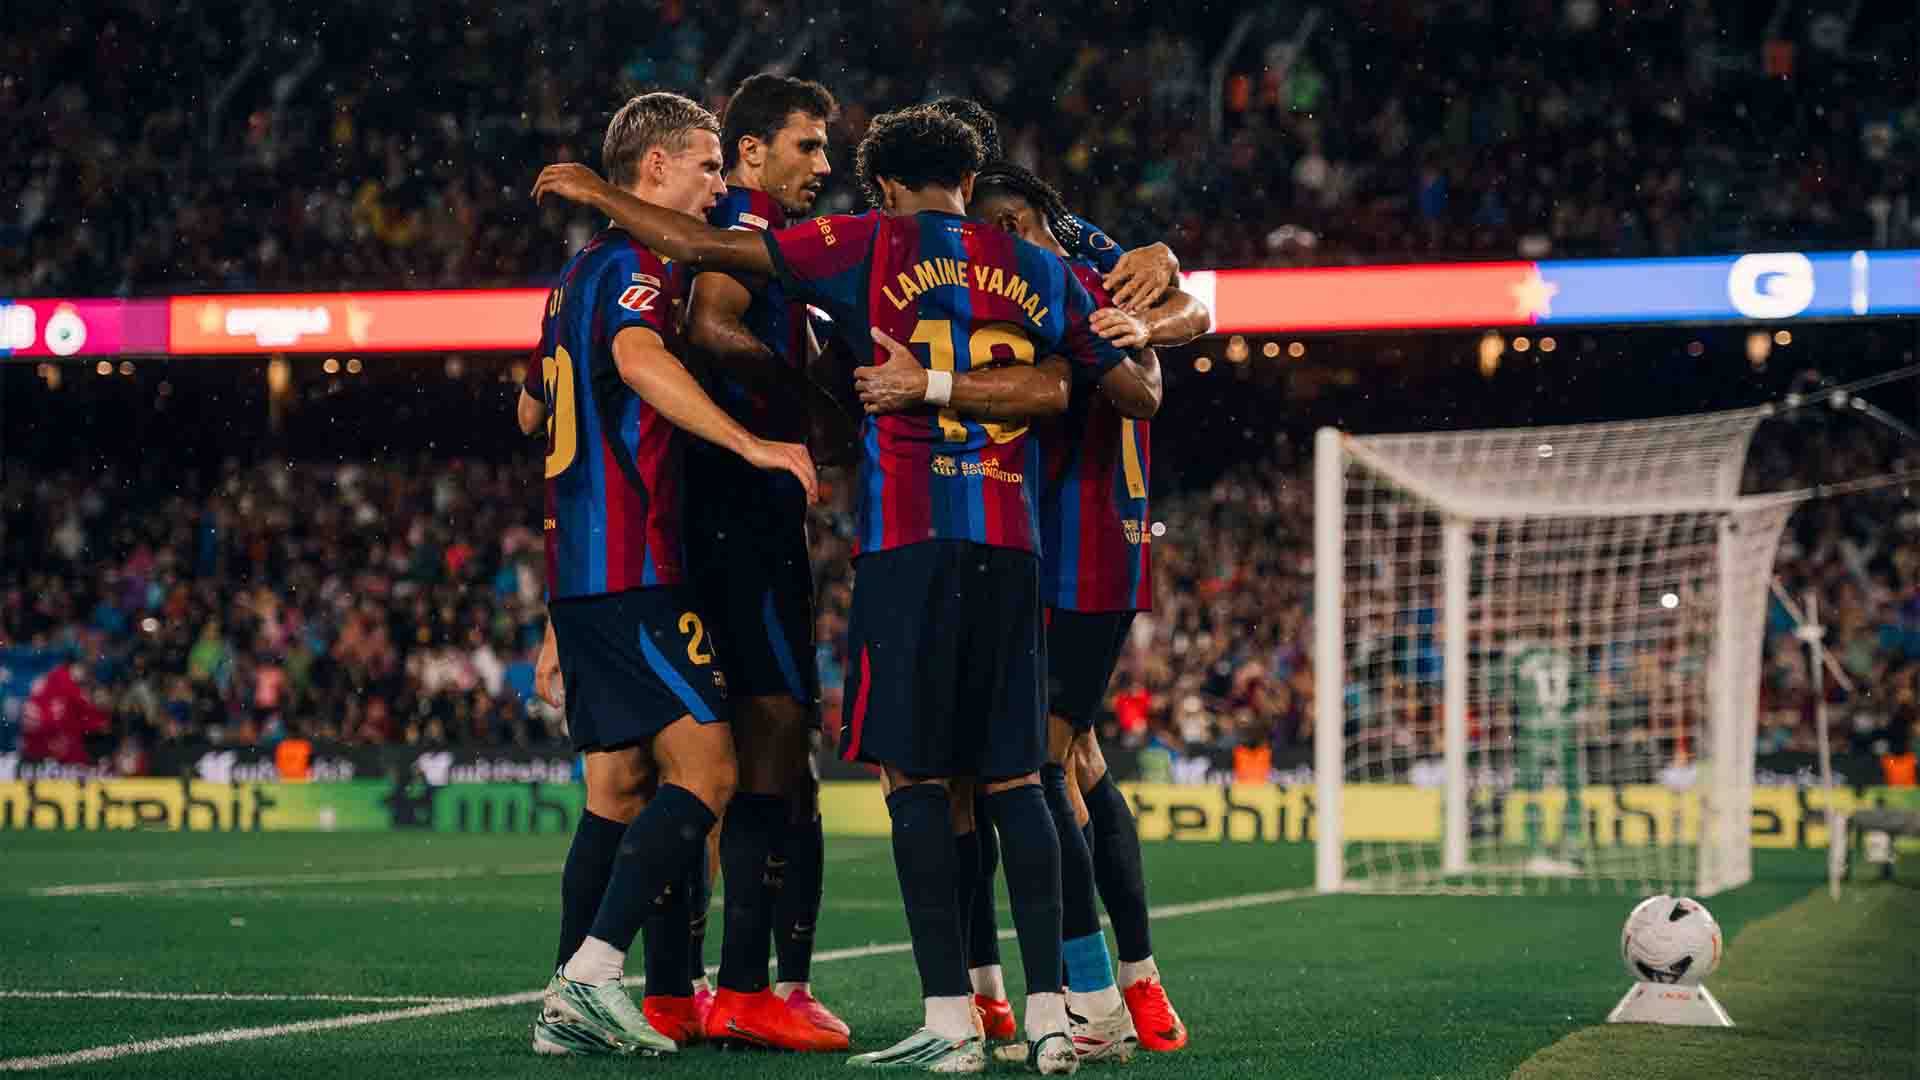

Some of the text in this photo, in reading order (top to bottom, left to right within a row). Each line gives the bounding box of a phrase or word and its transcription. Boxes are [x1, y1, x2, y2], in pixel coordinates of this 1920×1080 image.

[881, 256, 1049, 327] LAMINE YAMAL
[678, 611, 712, 665] 2
